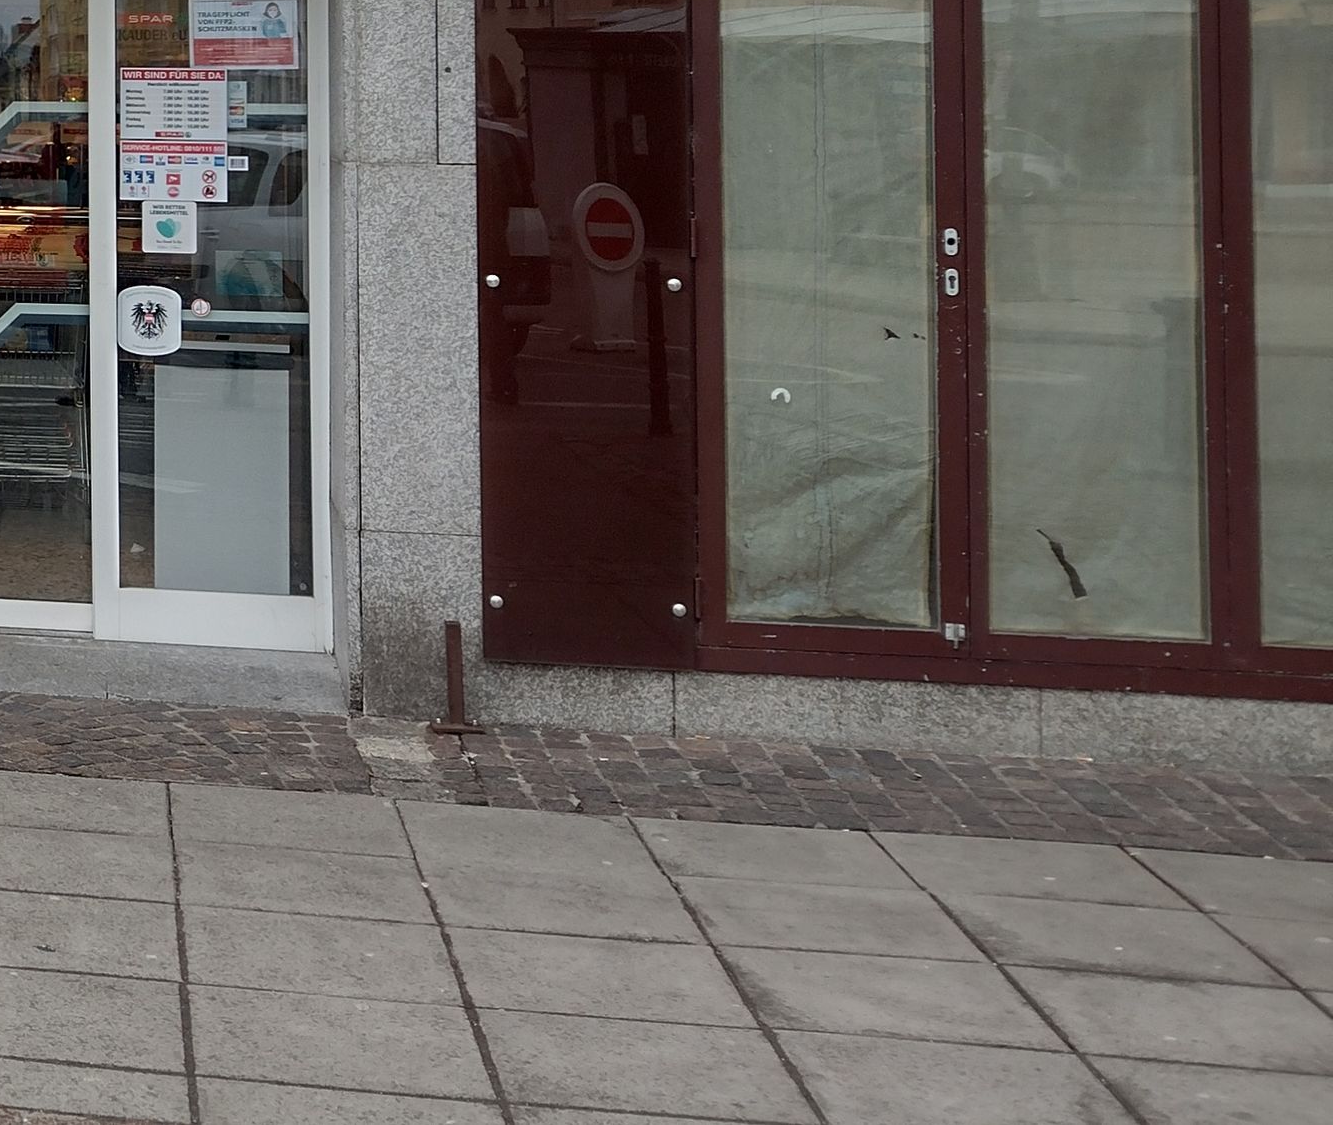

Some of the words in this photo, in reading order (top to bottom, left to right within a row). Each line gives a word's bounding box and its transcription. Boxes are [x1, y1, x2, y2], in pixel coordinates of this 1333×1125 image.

[128, 14, 174, 24] SPAR
[123, 71, 143, 79] WIR
[144, 71, 167, 79] SIND
[169, 70, 189, 80] FÜR
[190, 72, 207, 80] SIE
[207, 72, 224, 80] DA:
